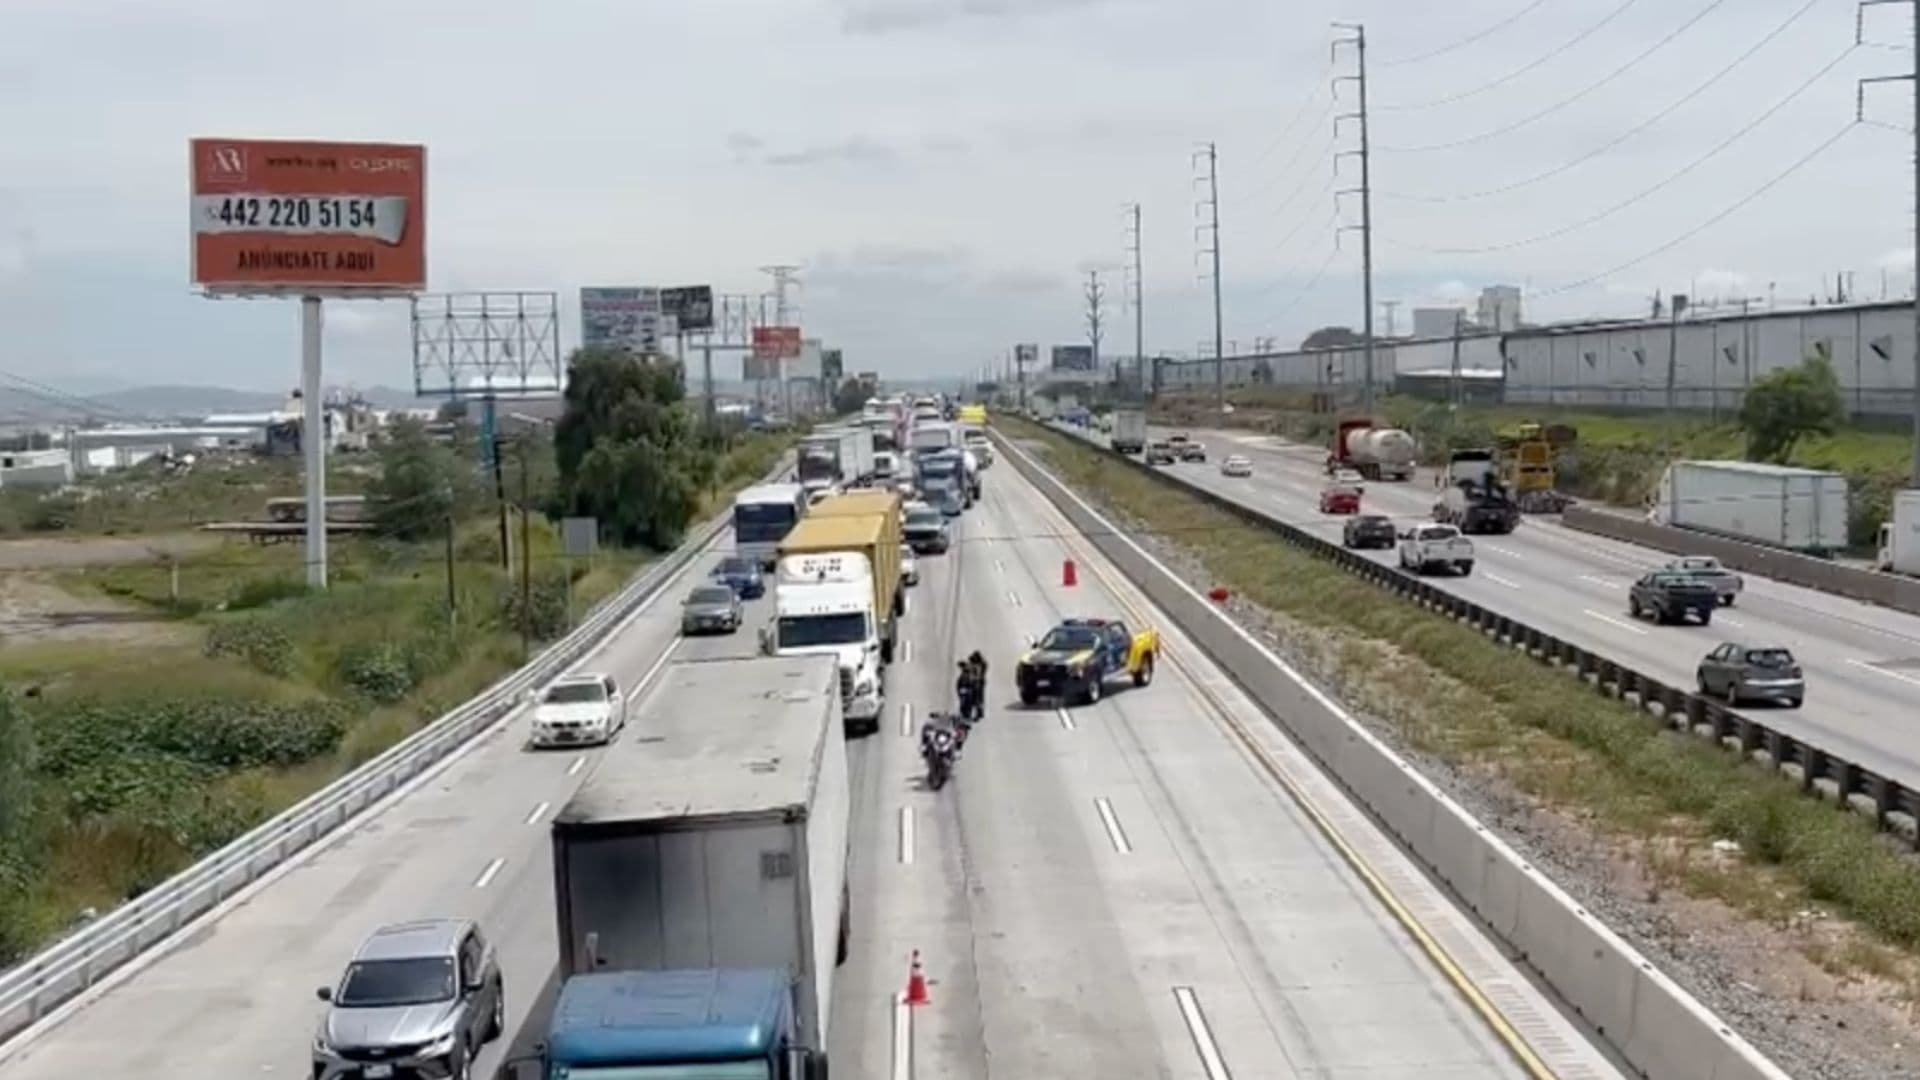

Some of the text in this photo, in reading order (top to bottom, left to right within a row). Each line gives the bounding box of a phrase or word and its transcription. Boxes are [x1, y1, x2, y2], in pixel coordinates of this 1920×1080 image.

[220, 198, 376, 227] 442 220 51 54
